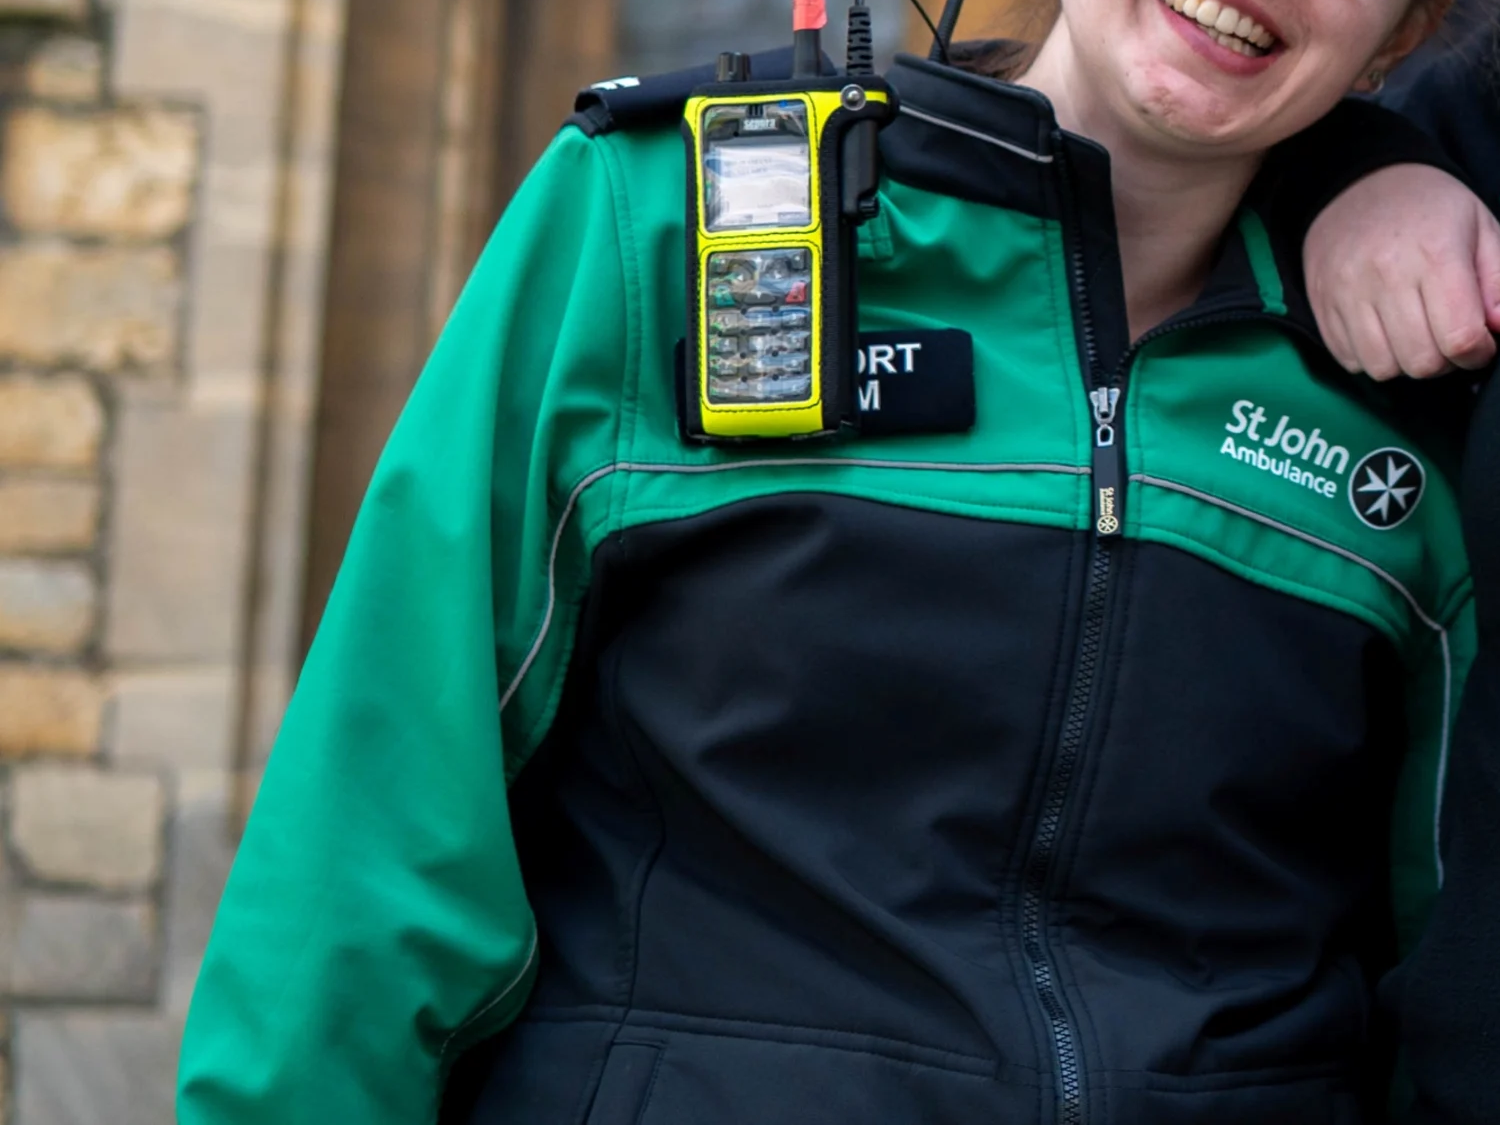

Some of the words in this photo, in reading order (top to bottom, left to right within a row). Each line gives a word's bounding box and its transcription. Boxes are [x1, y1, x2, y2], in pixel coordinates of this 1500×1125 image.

[1219, 436, 1337, 499] Ambulance
[1224, 399, 1268, 442] St
[1263, 415, 1350, 475] John
